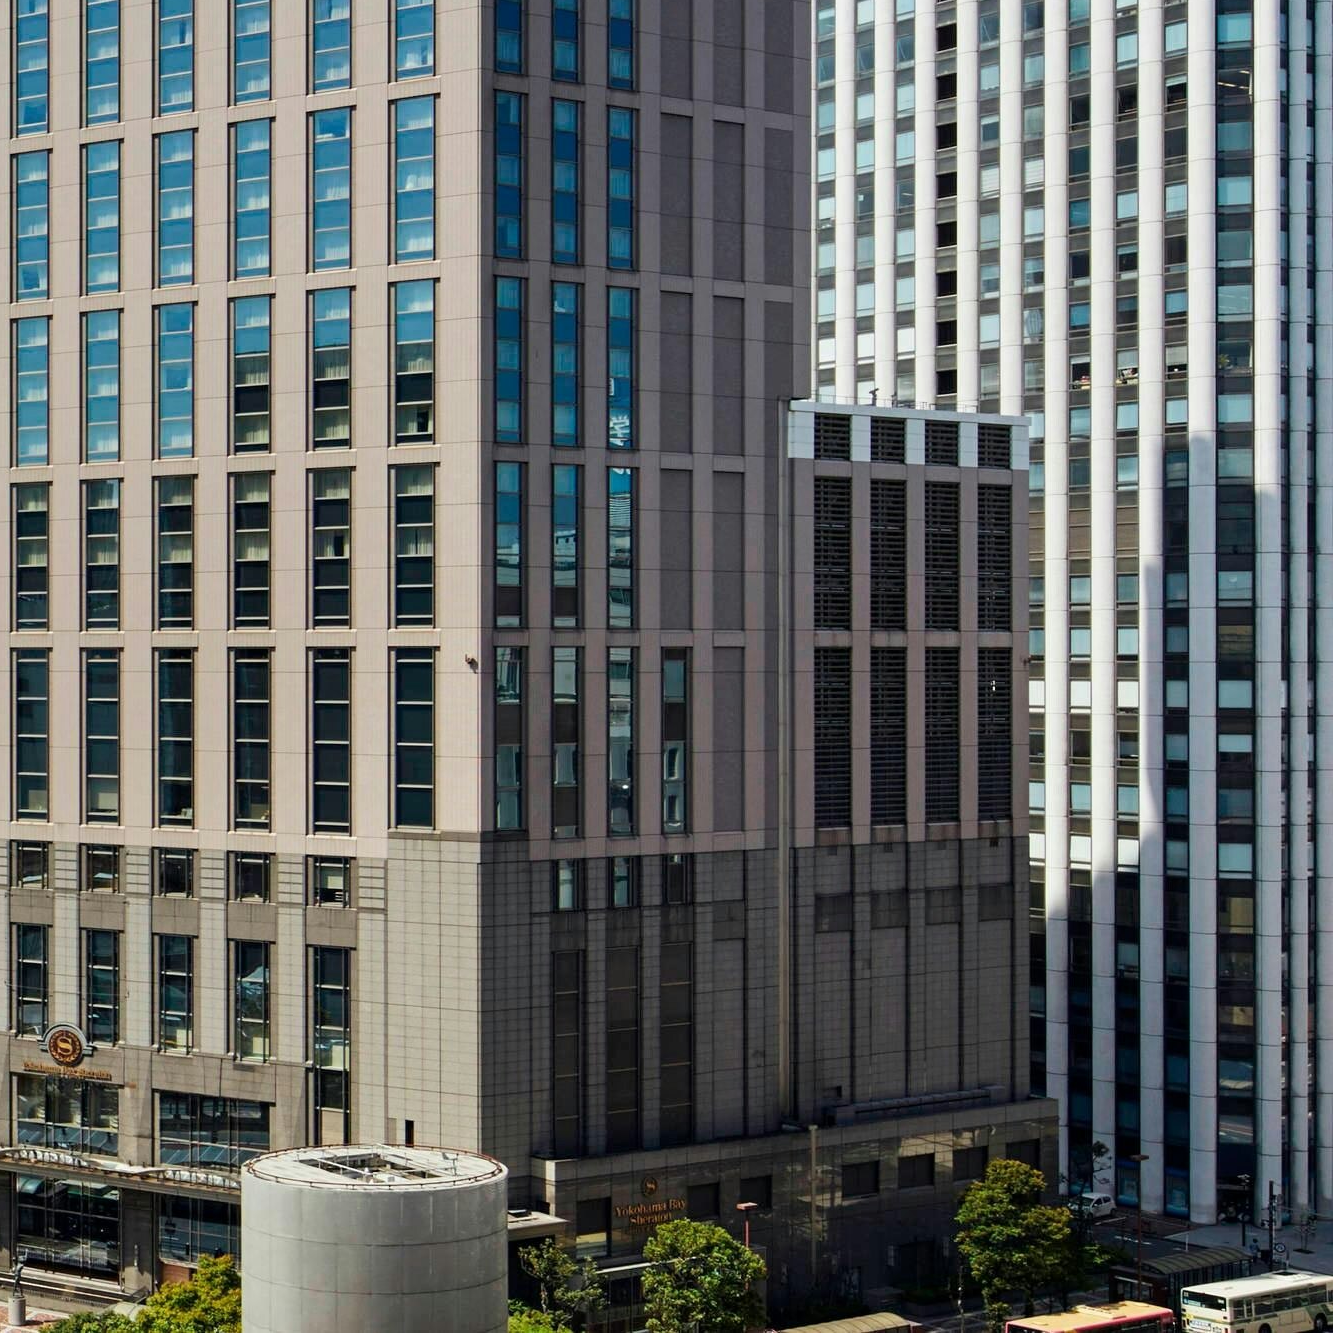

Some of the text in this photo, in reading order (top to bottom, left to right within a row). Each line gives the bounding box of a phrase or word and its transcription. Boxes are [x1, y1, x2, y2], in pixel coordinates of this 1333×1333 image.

[615, 1198, 686, 1217] Yokohama Bay
[629, 1212, 671, 1225] Sheraton
